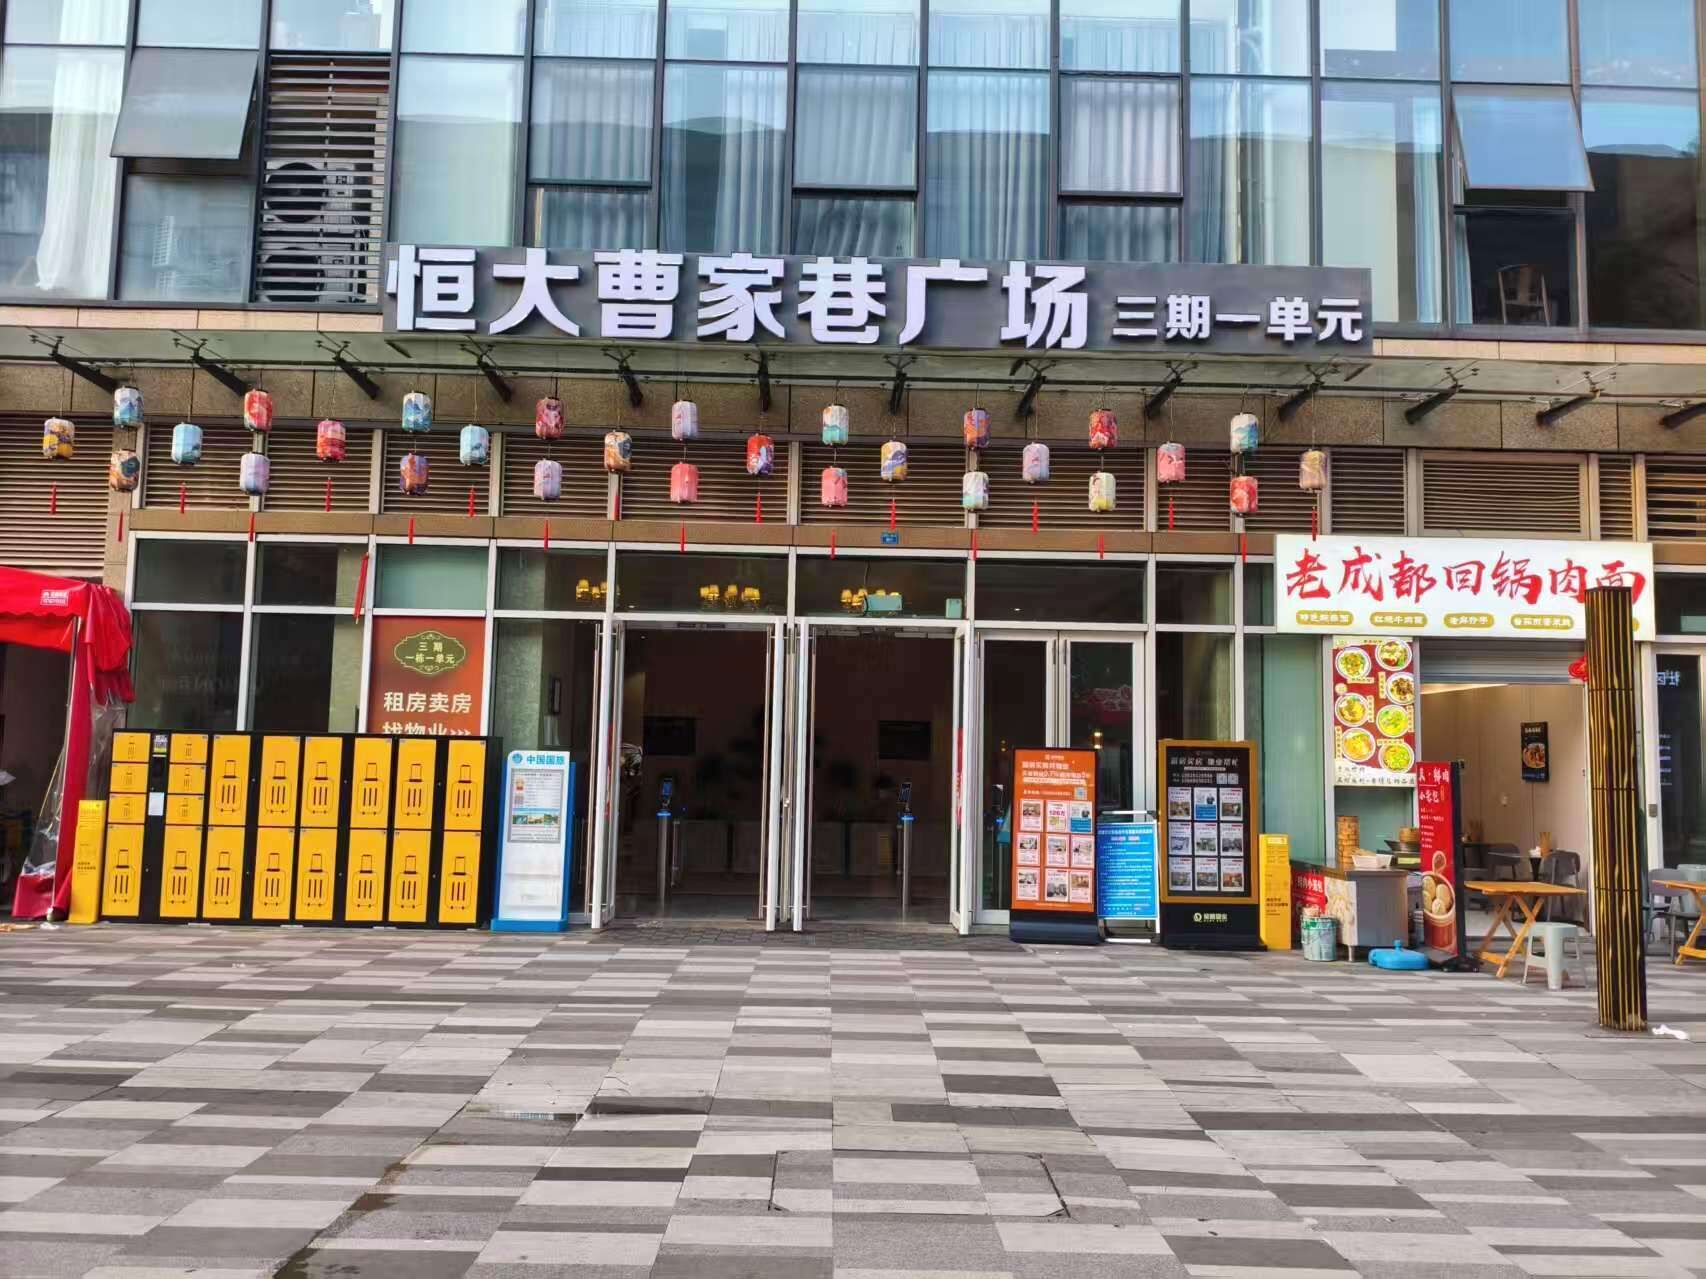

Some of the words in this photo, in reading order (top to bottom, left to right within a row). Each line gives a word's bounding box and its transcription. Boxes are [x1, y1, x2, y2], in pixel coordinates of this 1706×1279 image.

[386, 244, 1090, 350] 恒大曹家巷广场
[1112, 293, 1365, 343] 三期一单元
[1286, 546, 1646, 605] 老成都回锅肉面
[404, 652, 456, 664] 一栋一单元
[418, 641, 443, 652] 三期
[383, 691, 473, 714] 租房卖房
